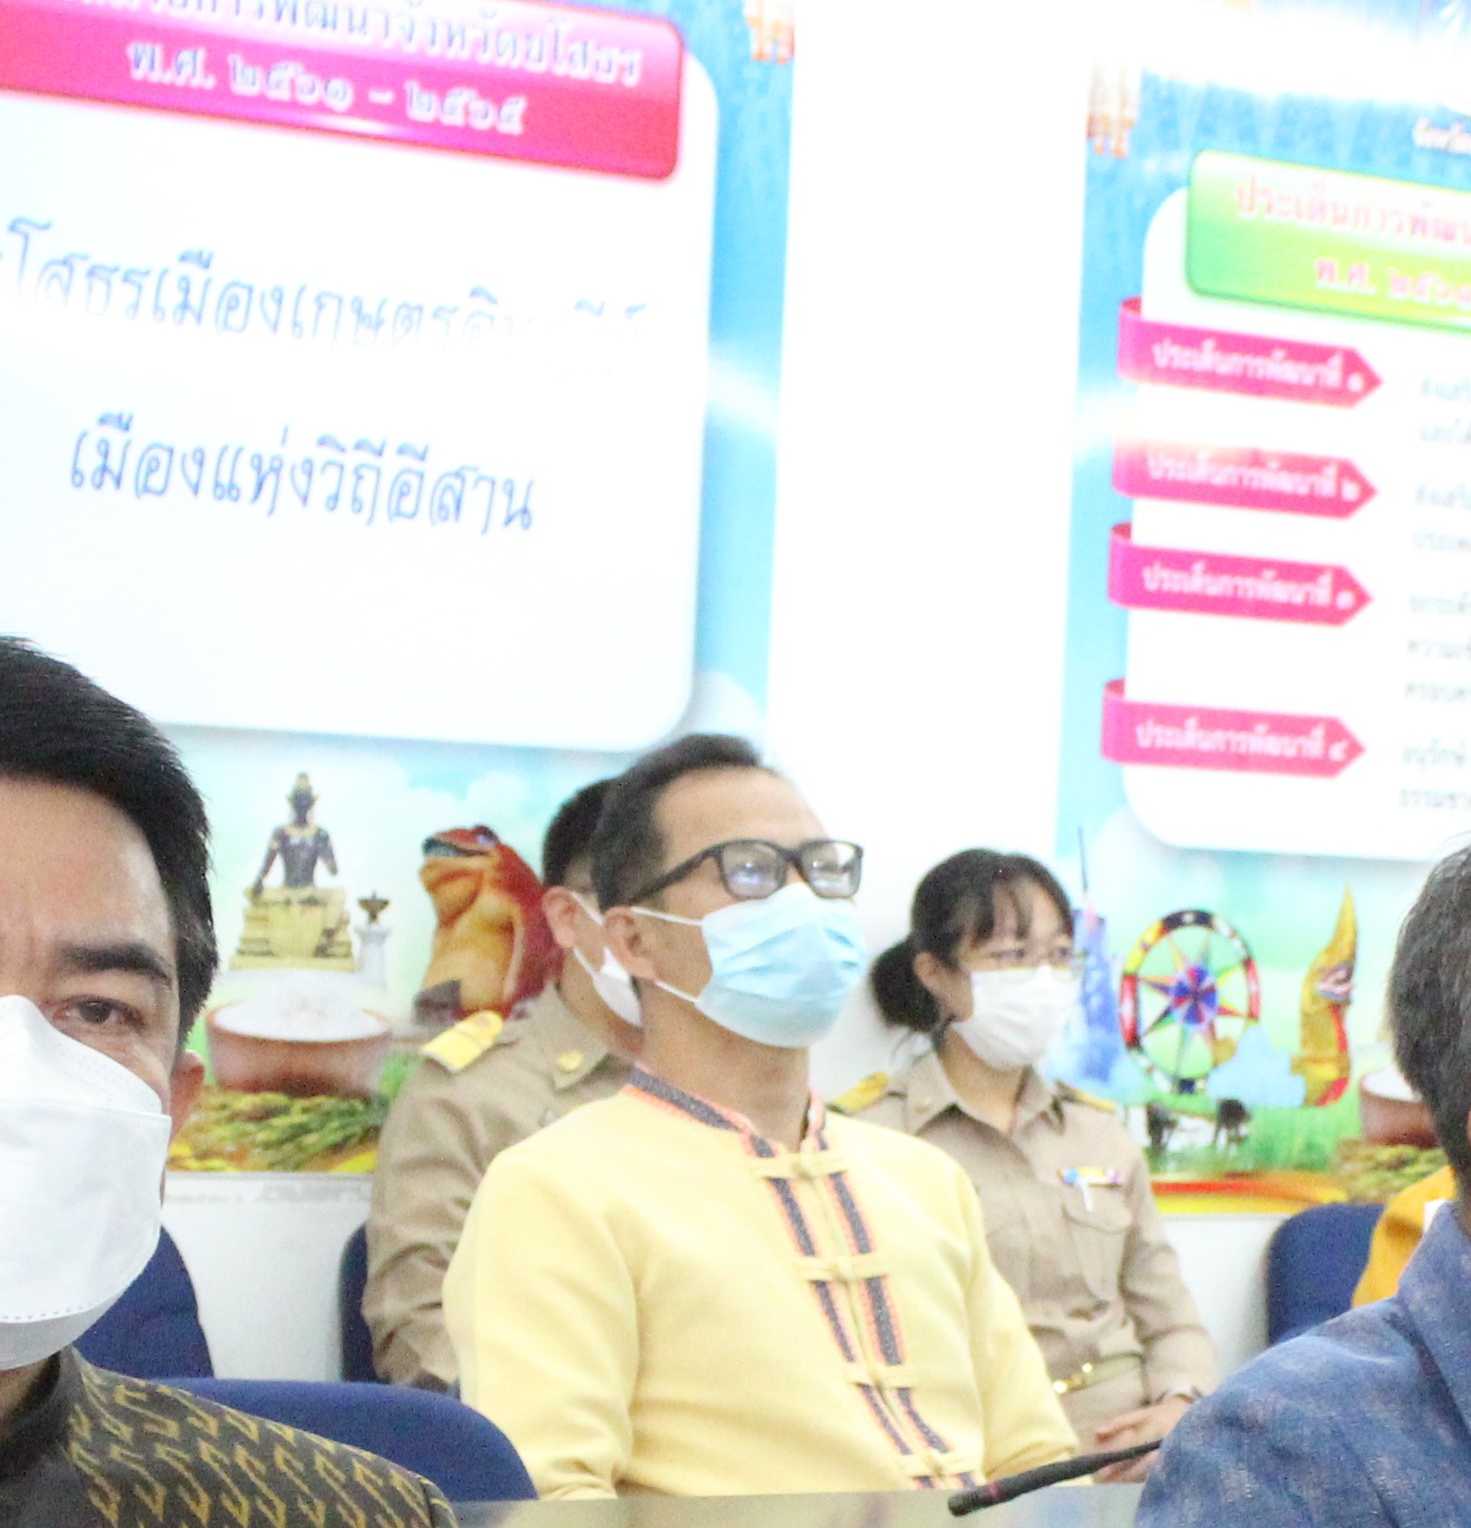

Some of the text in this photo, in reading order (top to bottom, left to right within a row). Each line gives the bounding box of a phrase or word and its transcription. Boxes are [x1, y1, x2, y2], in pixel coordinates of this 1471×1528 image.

[127, 41, 216, 90] พ.ศ.
[228, 54, 355, 112] ๒๕๖๑
[404, 79, 527, 135] ๒๕๖๕
[1315, 256, 1377, 296] พ.ศ.
[1152, 338, 1344, 389] ประเด็นการพัฒนาที่
[69, 412, 536, 538] เมืองแห่งวิถีอีสาน
[1147, 450, 1339, 498] ประเด็นการพัฒนาที่
[1143, 560, 1333, 608] ประเด็นการพัฒนาที่
[1136, 715, 1326, 760] ประเด็นการพัฒนาที่
